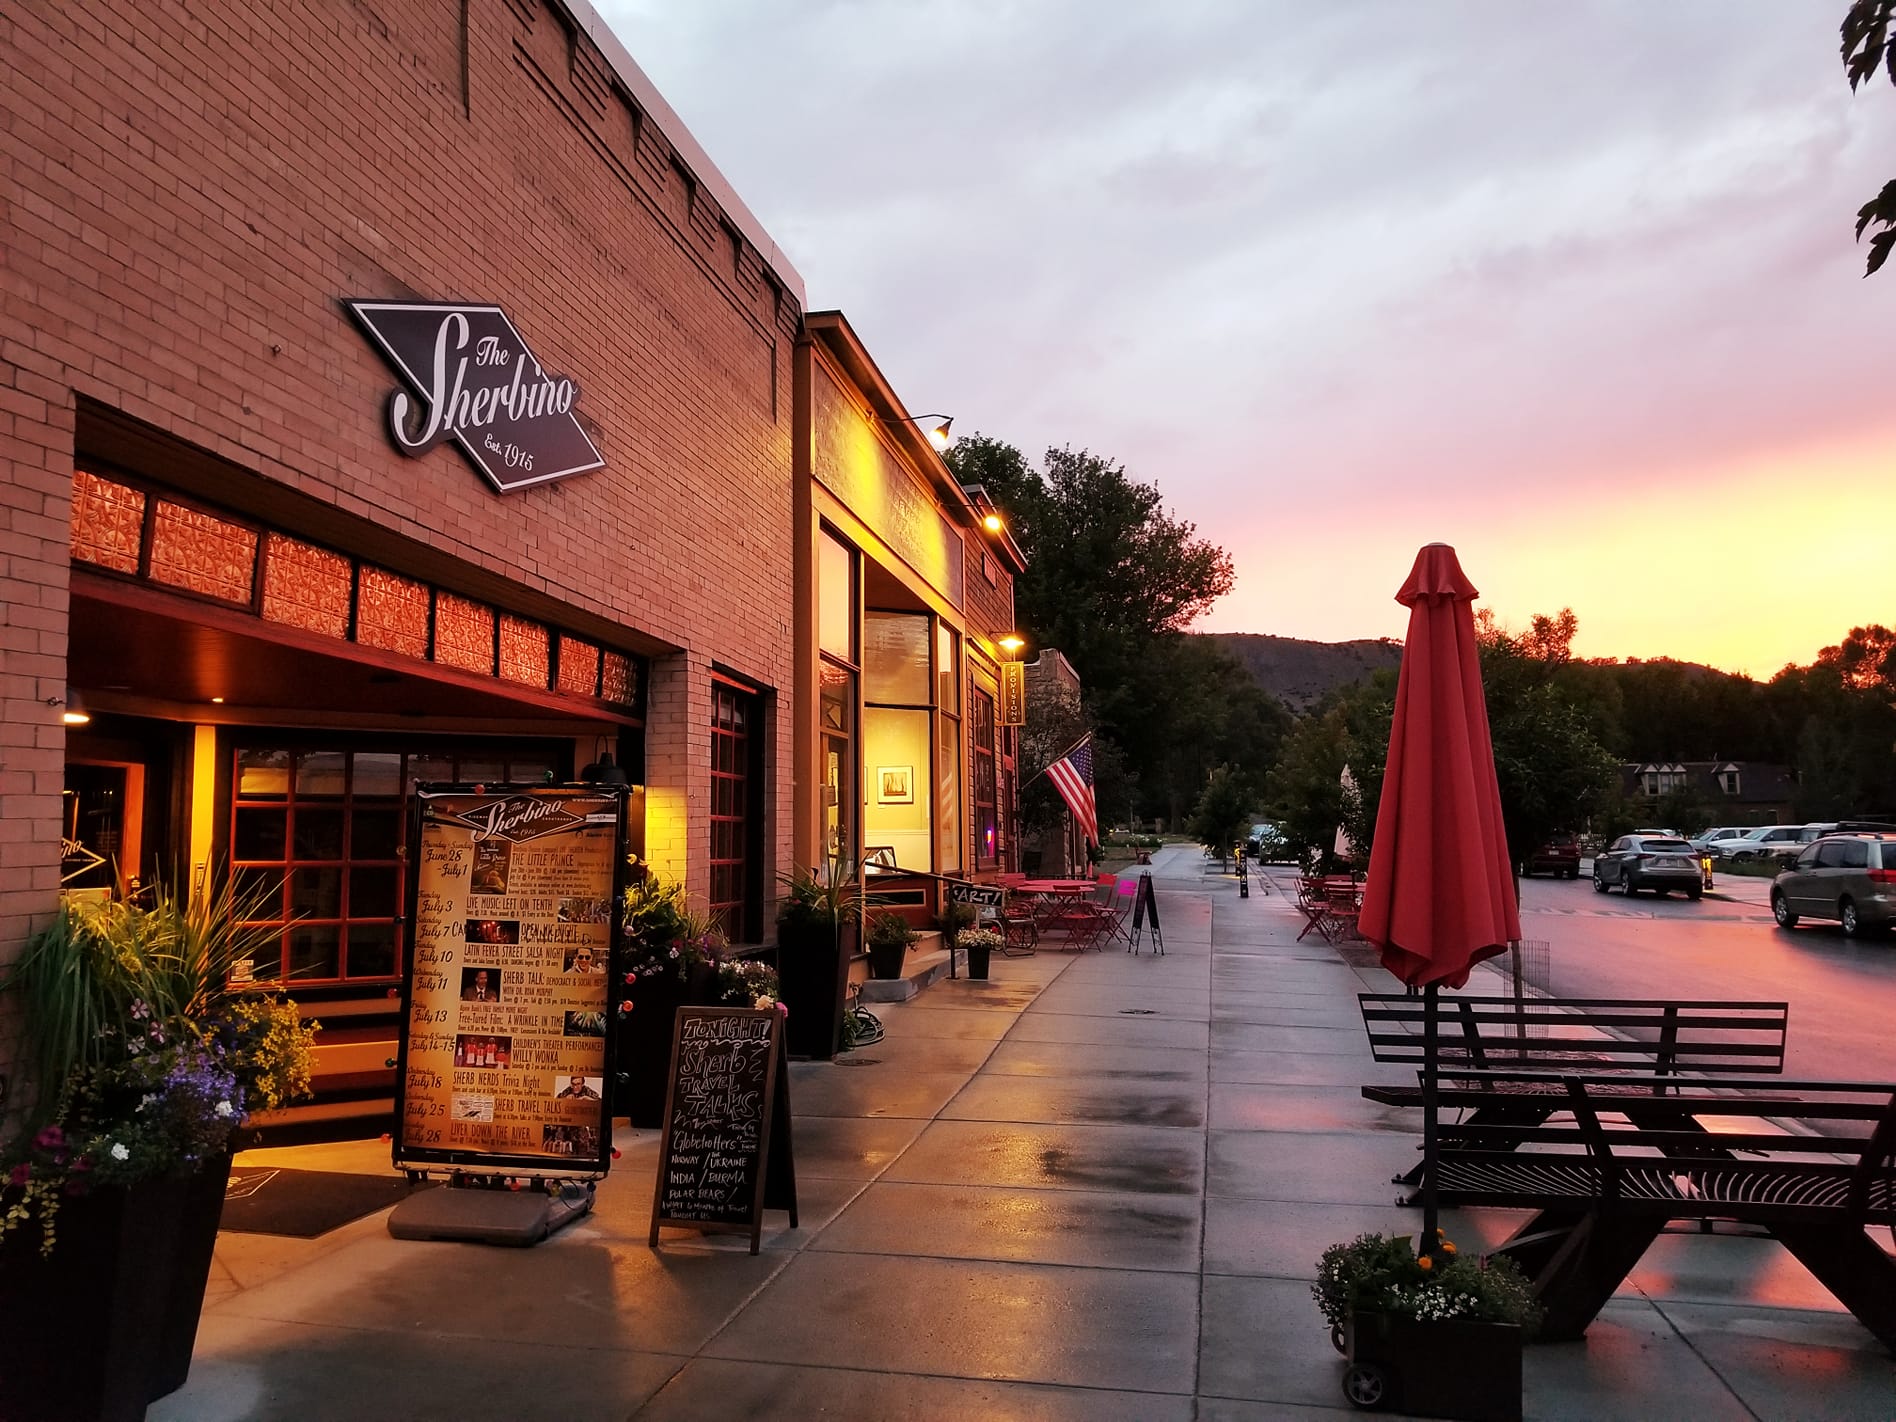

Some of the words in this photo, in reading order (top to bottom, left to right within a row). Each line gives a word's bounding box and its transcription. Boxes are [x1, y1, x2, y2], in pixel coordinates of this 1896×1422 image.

[476, 336, 510, 366] The
[393, 312, 578, 447] Sherbino
[484, 434, 502, 456] Est.
[504, 443, 534, 471] 1915
[471, 800, 565, 843] Sherbino
[425, 849, 447, 863] June
[448, 849, 463, 862] 28
[512, 853, 524, 866] THE
[528, 853, 547, 866] LITTLE
[550, 854, 574, 867] PRINCE
[422, 900, 443, 915] July
[445, 900, 453, 912] 3
[466, 896, 478, 909] LIVE
[503, 897, 516, 910] LEFT
[520, 898, 529, 910] ON
[533, 899, 553, 911] TENTH
[420, 924, 441, 940] July
[443, 926, 450, 937] 7
[419, 949, 438, 965] July
[440, 950, 453, 962] 10
[464, 944, 480, 956] LATIN
[482, 945, 499, 957] FEVER
[502, 946, 524, 958] STREET
[526, 947, 543, 958] SALSA
[546, 947, 563, 959] NIGHT
[416, 977, 436, 992] July
[438, 977, 448, 990] 11
[503, 970, 524, 984] SHERB
[546, 976, 571, 986] DEMOCRACY
[414, 1009, 433, 1024] July
[435, 1010, 448, 1022] 13
[508, 1014, 512, 1024] A
[514, 1015, 538, 1026] WRINKLE
[541, 1015, 548, 1026] IN
[684, 1017, 772, 1040] TONIGHT!
[410, 1039, 428, 1052] July
[544, 1039, 562, 1049] THEATER
[512, 1049, 533, 1063] WILLY
[535, 1050, 560, 1064] WONKA
[680, 1047, 747, 1078] Sherb
[407, 1074, 429, 1090] July
[431, 1076, 443, 1089] 18
[453, 1071, 475, 1085] SHERB
[478, 1072, 499, 1086] NERDS
[502, 1073, 520, 1087] Trivia
[523, 1074, 541, 1092] Night
[680, 1074, 740, 1096] TRAVEL
[406, 1102, 427, 1118] July
[429, 1103, 446, 1116] 25
[494, 1097, 514, 1112] SHERB
[518, 1099, 540, 1113] TRAVEL
[543, 1100, 562, 1114] TALKS
[684, 1091, 759, 1120] TALKS
[425, 1129, 442, 1143] 28
[450, 1122, 467, 1136] LIVER
[471, 1124, 491, 1137] DOWN
[495, 1125, 508, 1139] THE
[511, 1126, 530, 1140] RIVER
[710, 1157, 748, 1169] UKRAINE
[670, 1170, 695, 1184] INDIA
[708, 1170, 746, 1187] BURMA
[669, 1189, 695, 1199] POLAR
[698, 1189, 726, 1202] BEARS
